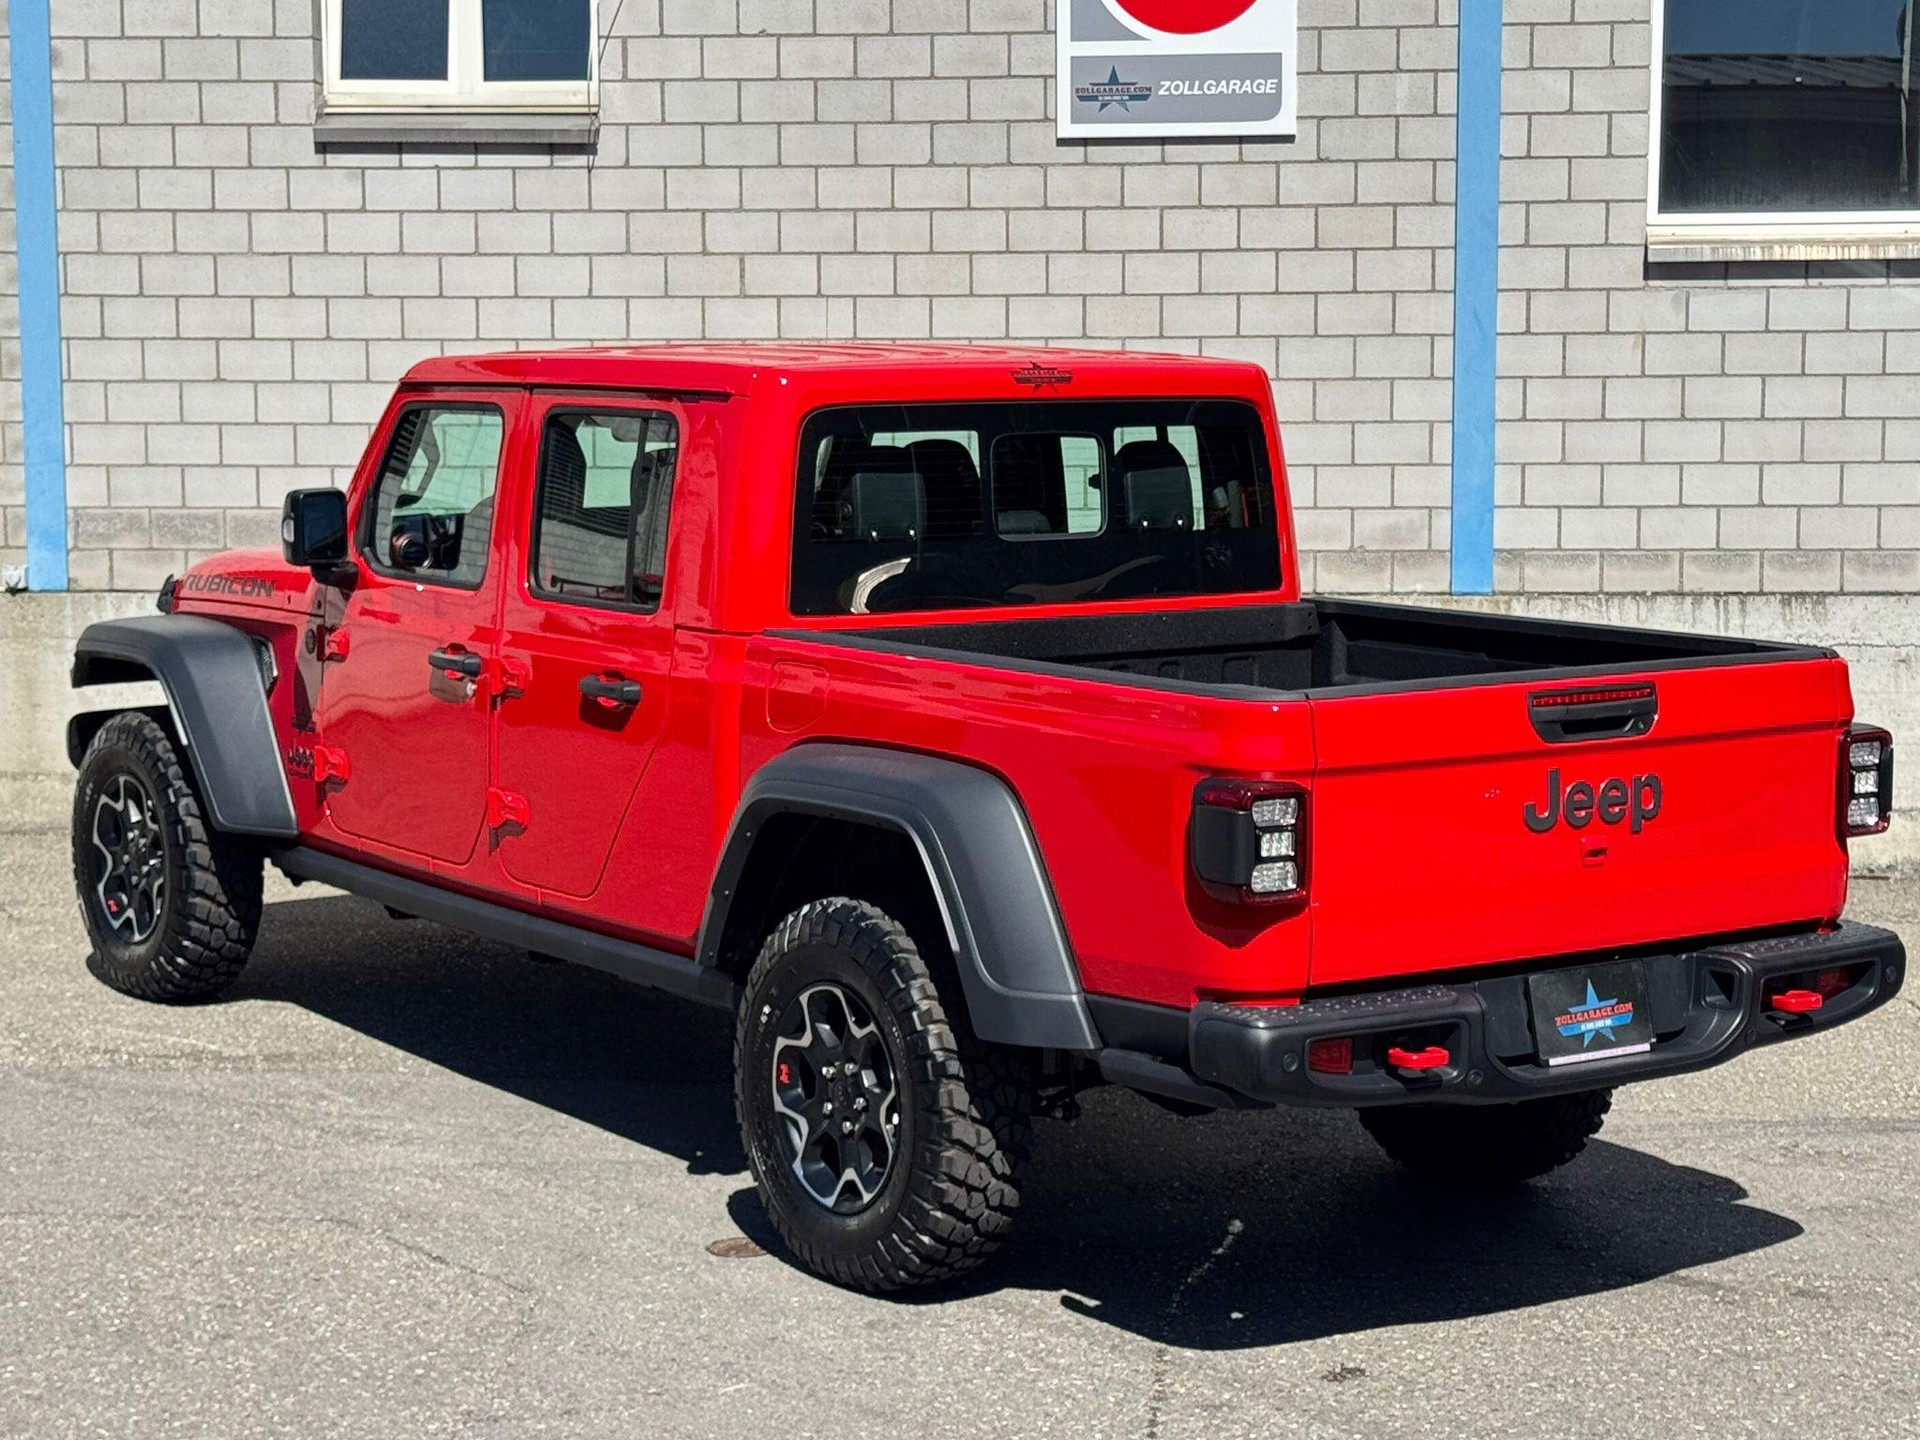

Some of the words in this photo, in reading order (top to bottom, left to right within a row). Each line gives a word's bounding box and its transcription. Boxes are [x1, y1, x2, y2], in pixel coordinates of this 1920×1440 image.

[1158, 79, 1279, 96] ZOLLGARAGE
[183, 573, 276, 598] RUBICON
[1524, 768, 1662, 834] Jeep
[1554, 1001, 1633, 1026] ZOLLGARAGE.COM
